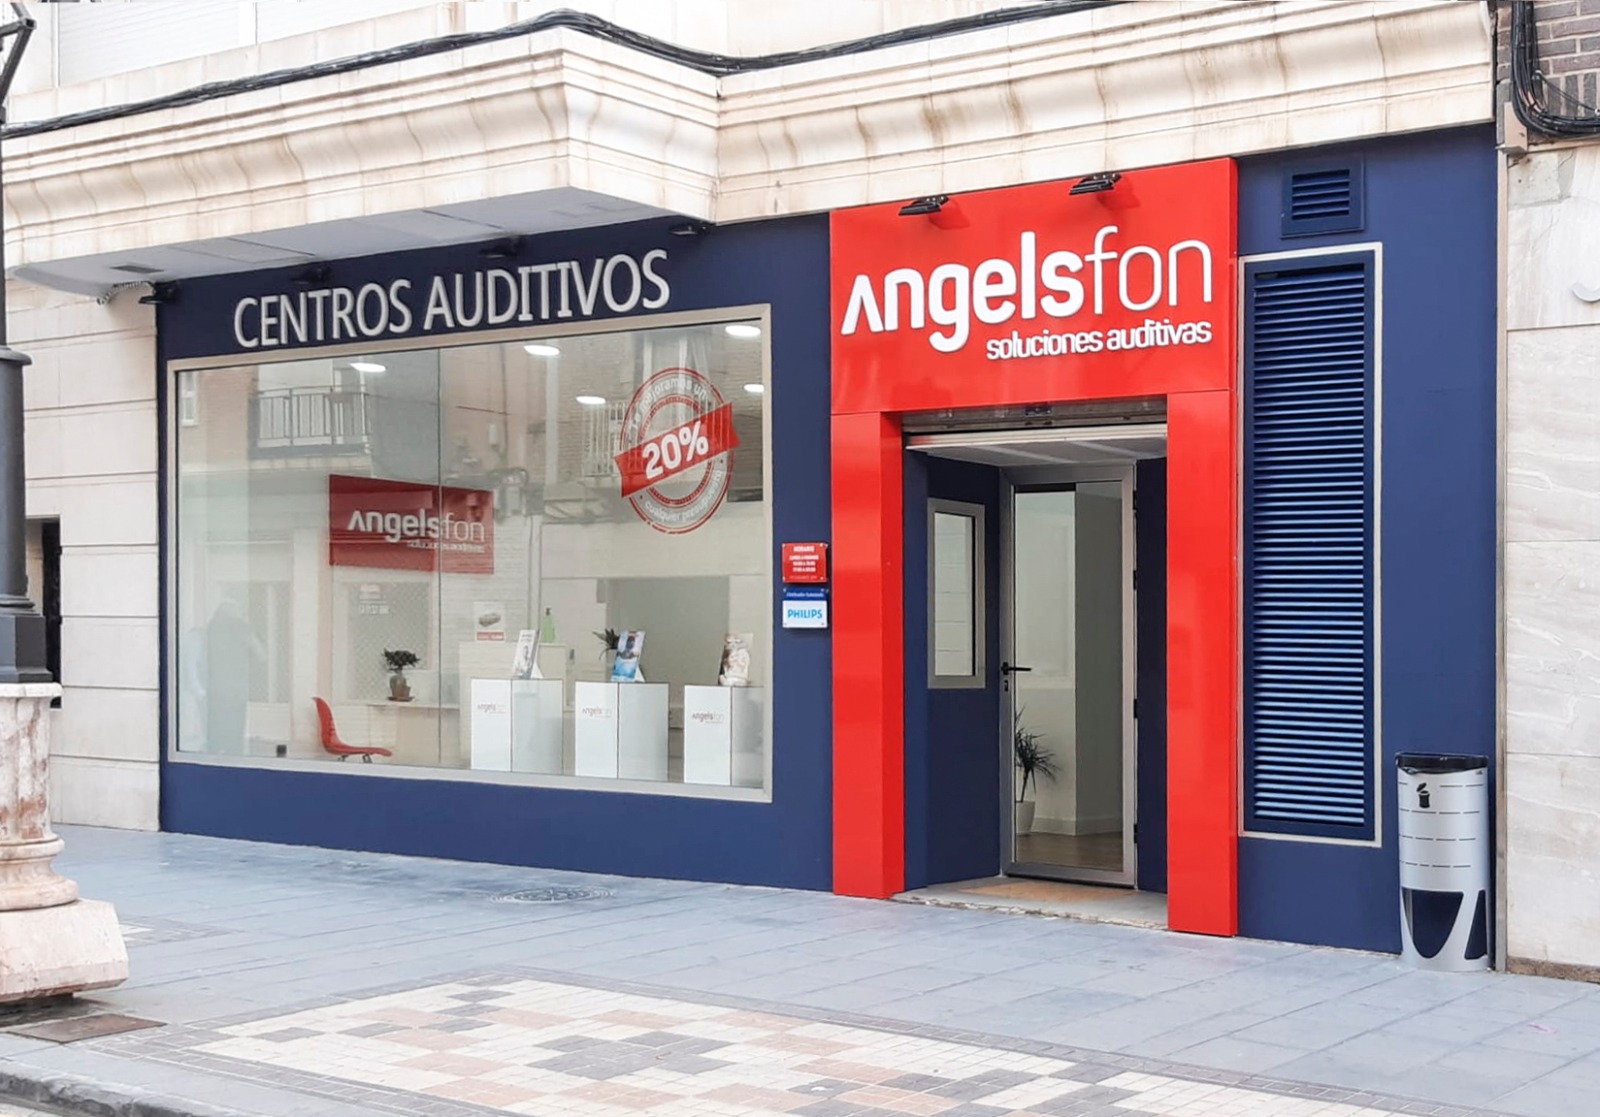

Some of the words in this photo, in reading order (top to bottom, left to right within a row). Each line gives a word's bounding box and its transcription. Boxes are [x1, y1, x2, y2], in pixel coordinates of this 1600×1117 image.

[234, 279, 412, 348] CENTROS
[424, 249, 670, 330] AUDITIVOS
[841, 225, 1213, 352] Angelsfon
[986, 330, 1103, 360] soluciones
[1106, 318, 1213, 351] auditivas
[640, 378, 693, 412] mejoramos
[694, 384, 709, 402] un
[642, 420, 709, 480] 20%
[787, 609, 823, 618] PHILIPS
